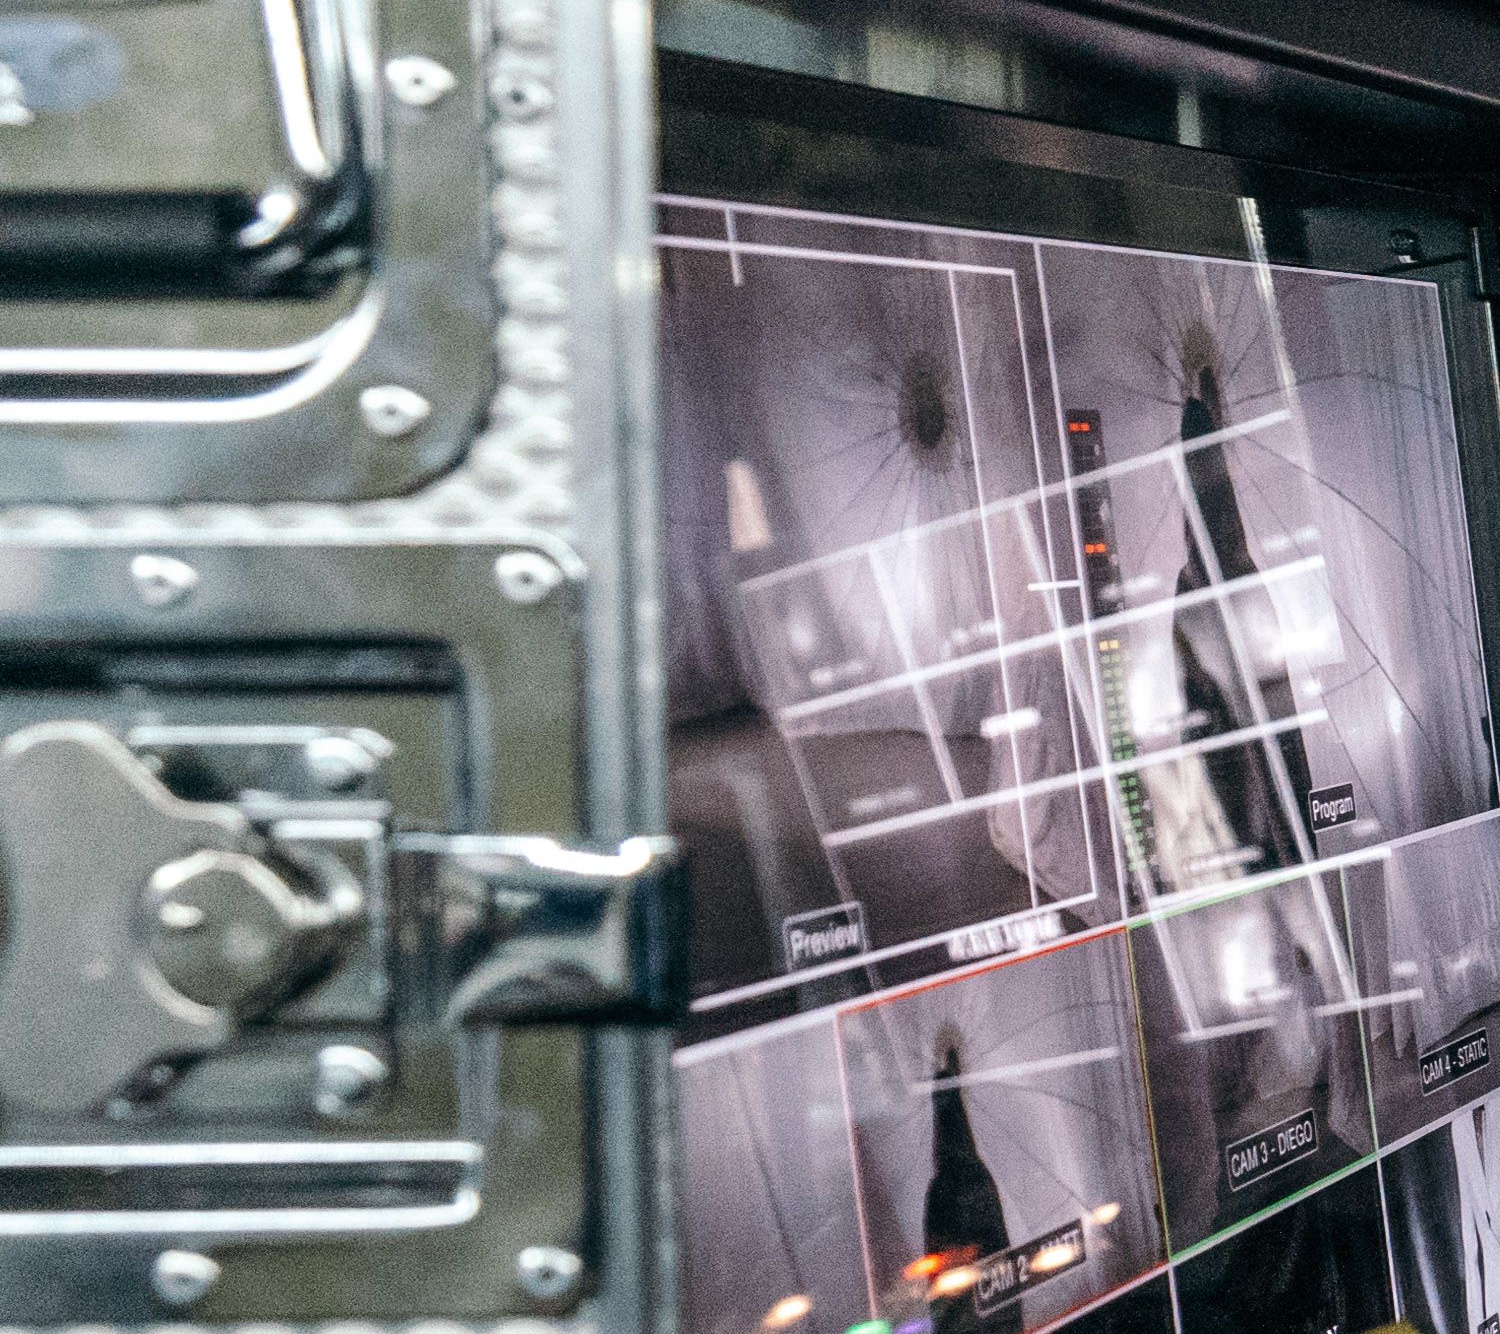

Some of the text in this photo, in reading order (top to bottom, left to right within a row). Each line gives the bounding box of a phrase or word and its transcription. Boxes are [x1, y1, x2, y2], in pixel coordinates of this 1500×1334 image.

[1312, 795, 1354, 823] Program
[790, 922, 861, 961] Preview
[1422, 1060, 1444, 1085] CAM
[1443, 1055, 1452, 1073] 4
[1457, 1037, 1488, 1069] STATIC
[1230, 1148, 1259, 1178] CAM
[1259, 1140, 1268, 1164] 3
[1277, 1119, 1314, 1154] DIEGO
